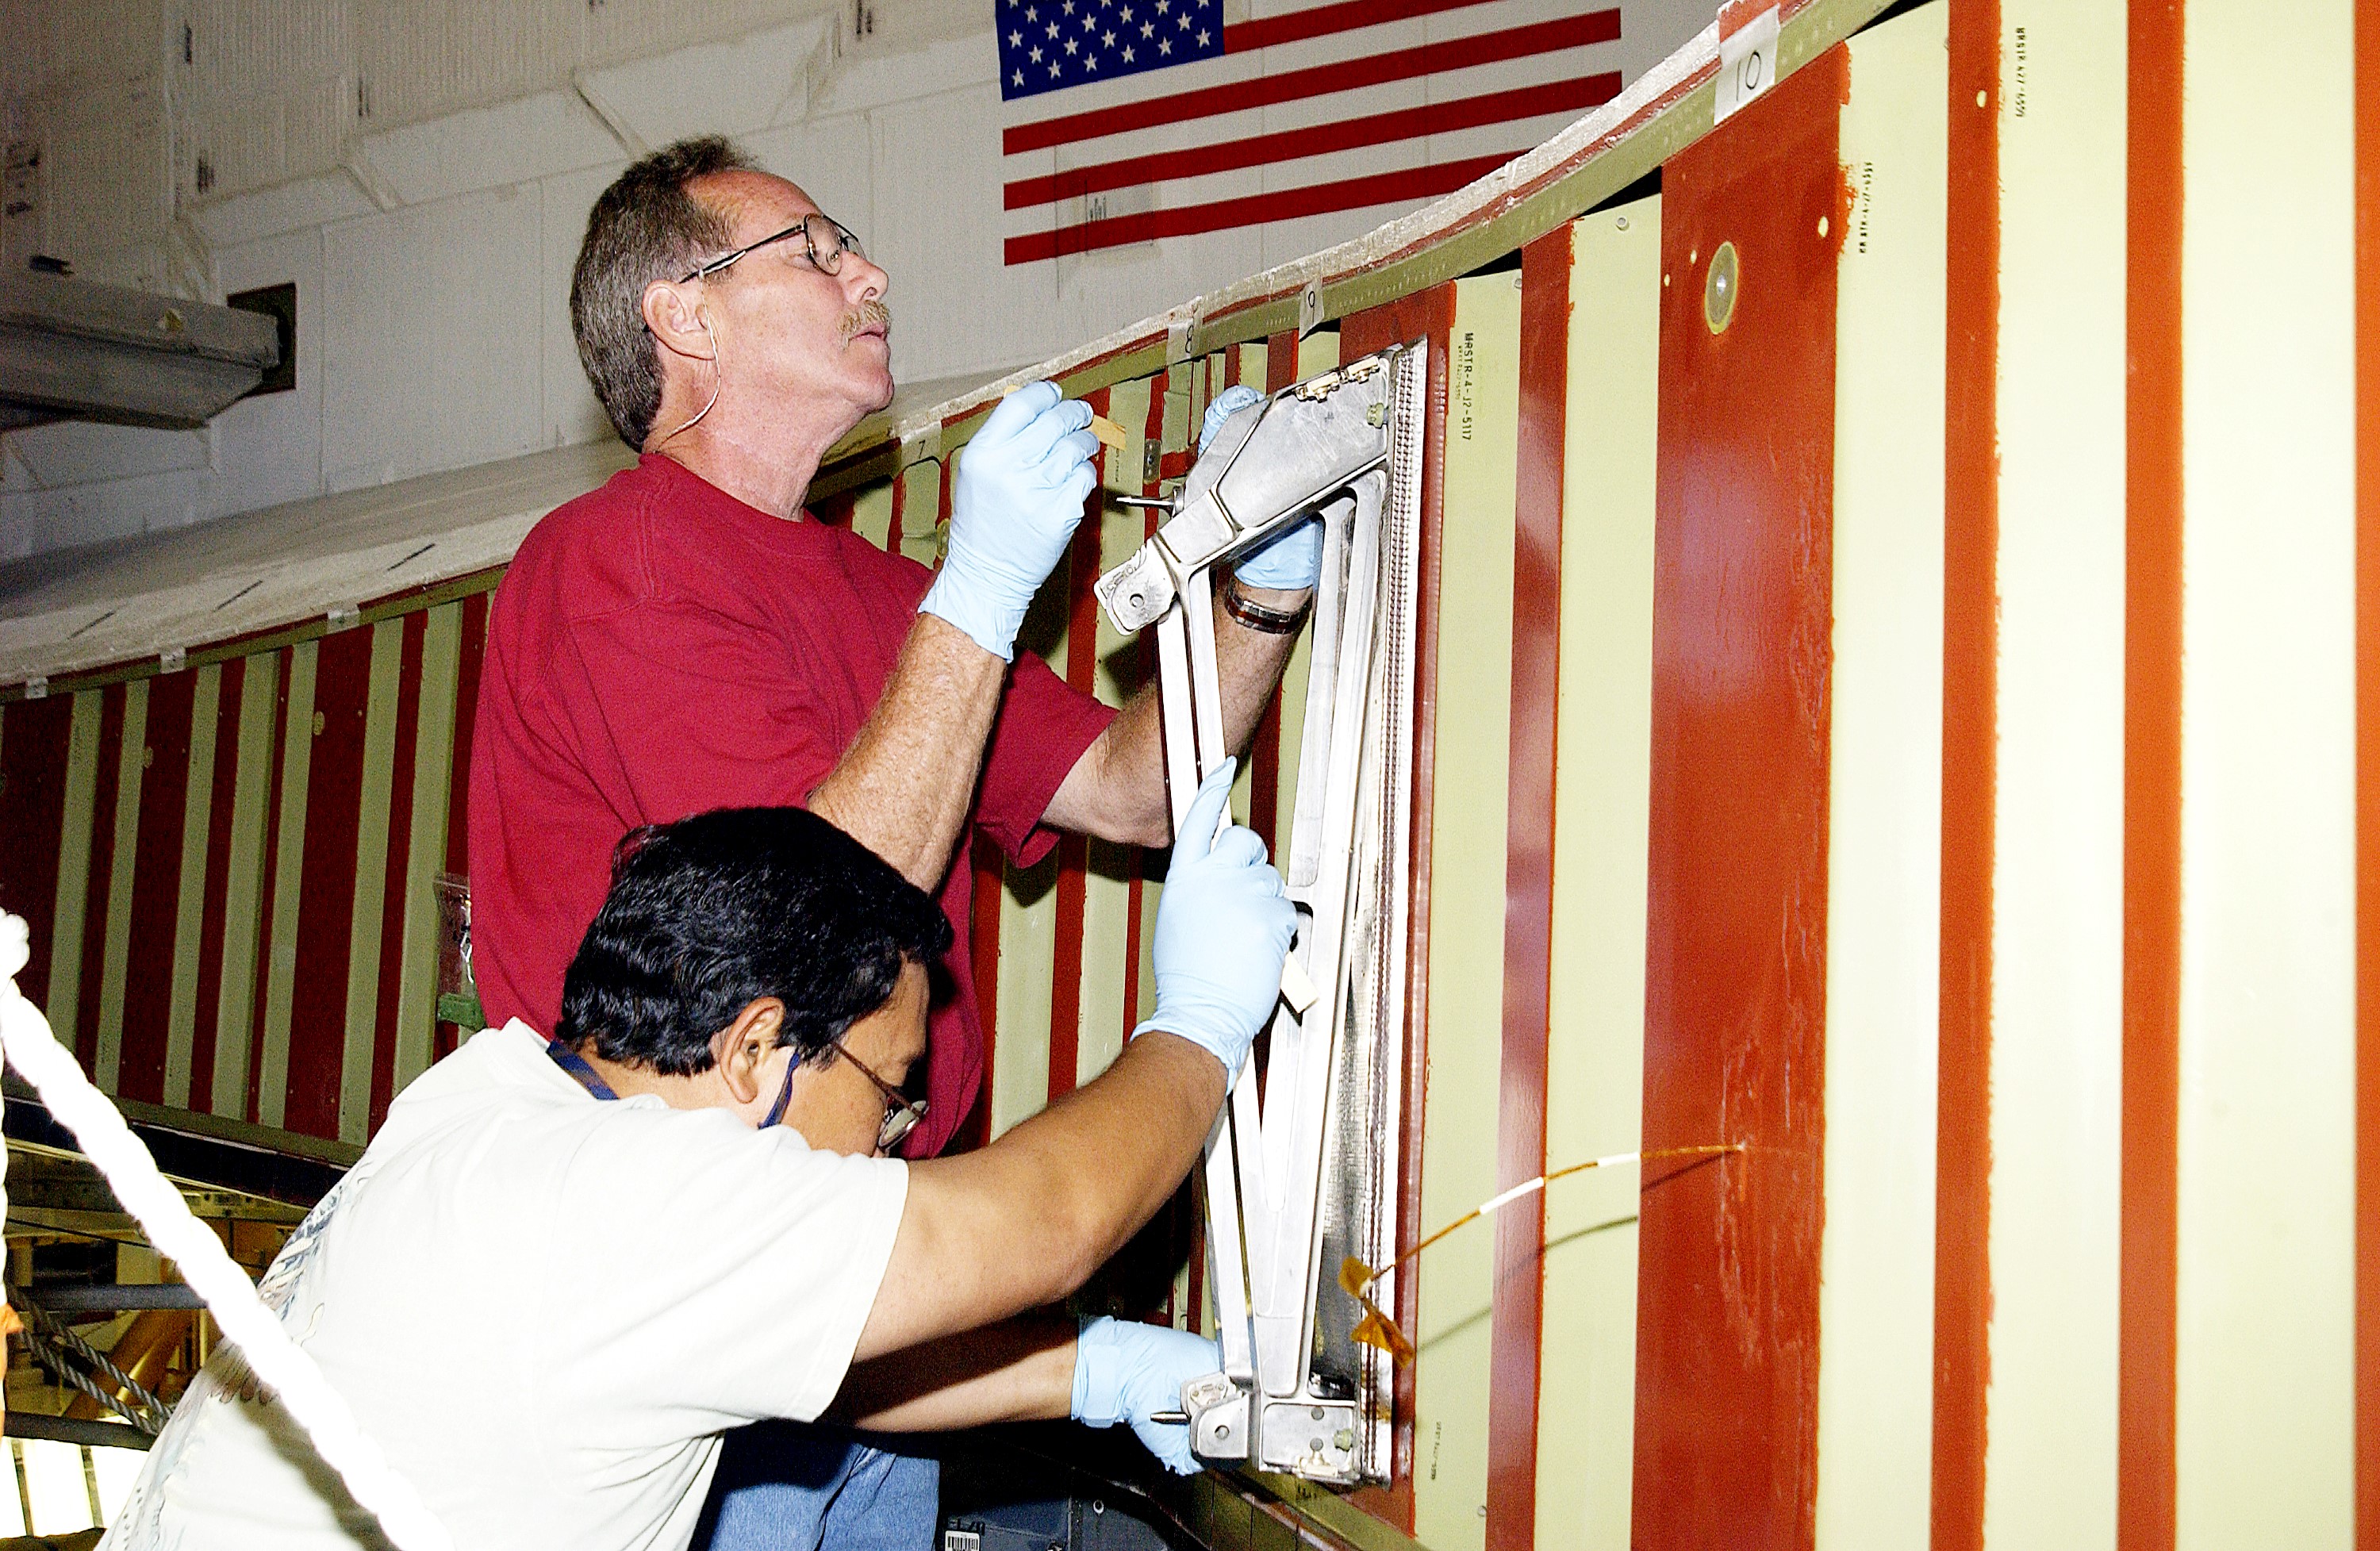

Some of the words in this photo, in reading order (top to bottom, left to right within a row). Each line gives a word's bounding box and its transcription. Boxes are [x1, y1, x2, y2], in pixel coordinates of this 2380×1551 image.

[1736, 49, 1761, 102] 10
[1307, 290, 1316, 324] 9
[1184, 324, 1194, 354] 8
[919, 440, 926, 459] 7
